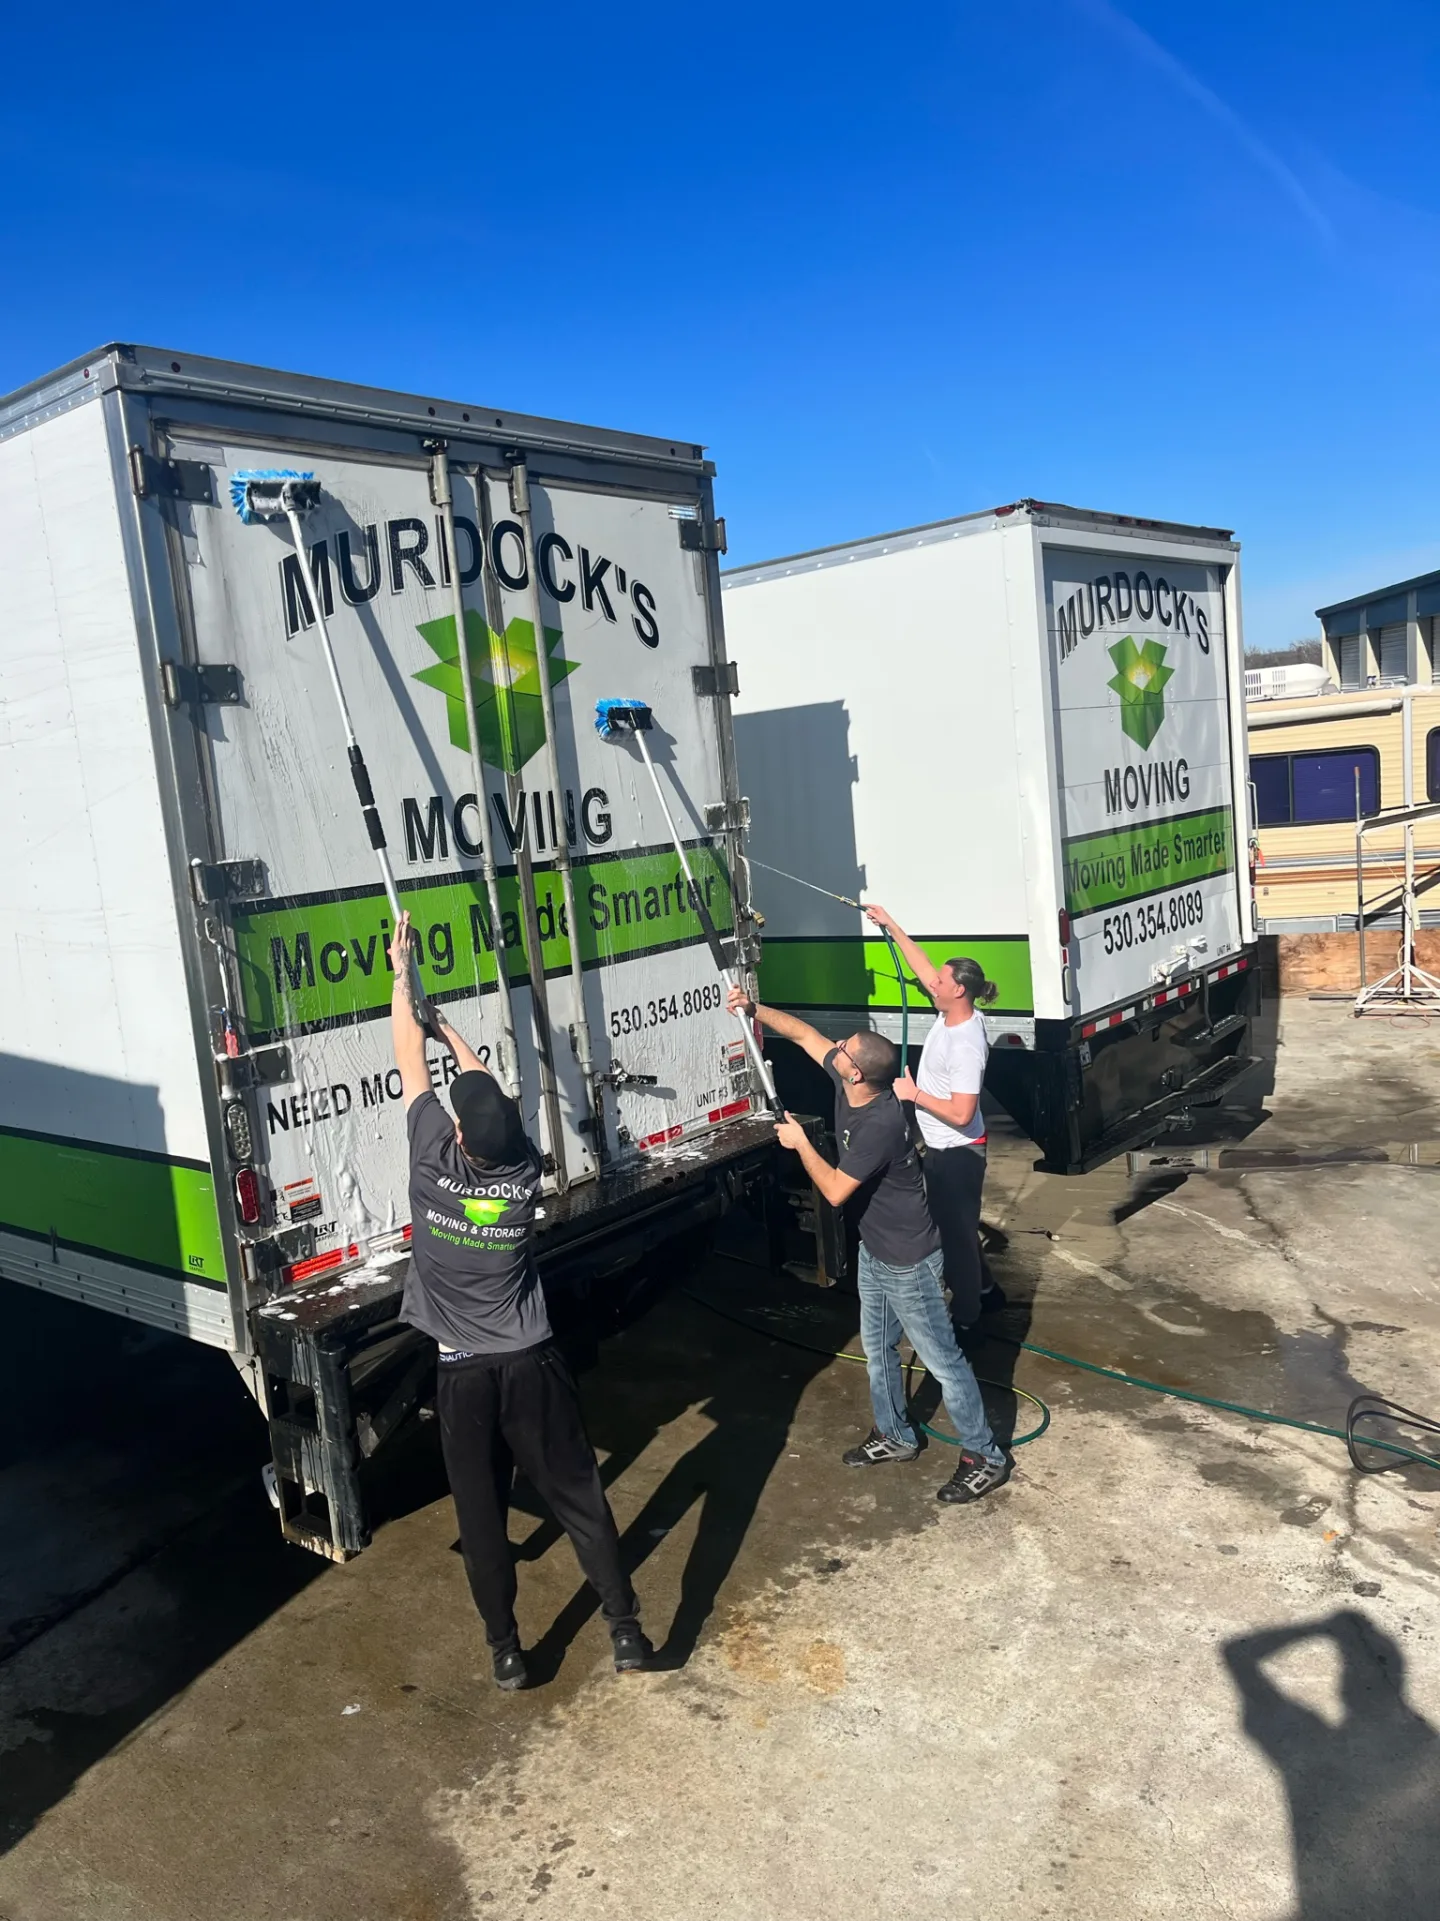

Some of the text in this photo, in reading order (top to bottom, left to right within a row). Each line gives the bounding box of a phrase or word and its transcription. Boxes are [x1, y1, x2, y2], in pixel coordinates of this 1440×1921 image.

[279, 514, 660, 650] MURDOCK'S
[1056, 570, 1210, 664] MURDOCK'S
[1104, 758, 1190, 816] MOVING
[401, 787, 613, 864] MOVING
[1067, 828, 1226, 893] Moving Made Smarter
[1103, 889, 1204, 955] 530.354.8089
[610, 983, 721, 1038] 530.354.8089
[266, 1082, 351, 1135] NEED
[696, 1089, 716, 1107] UNIT
[426, 1209, 526, 1239] MOVING & STORAGE
[462, 1236, 485, 1249] Made
